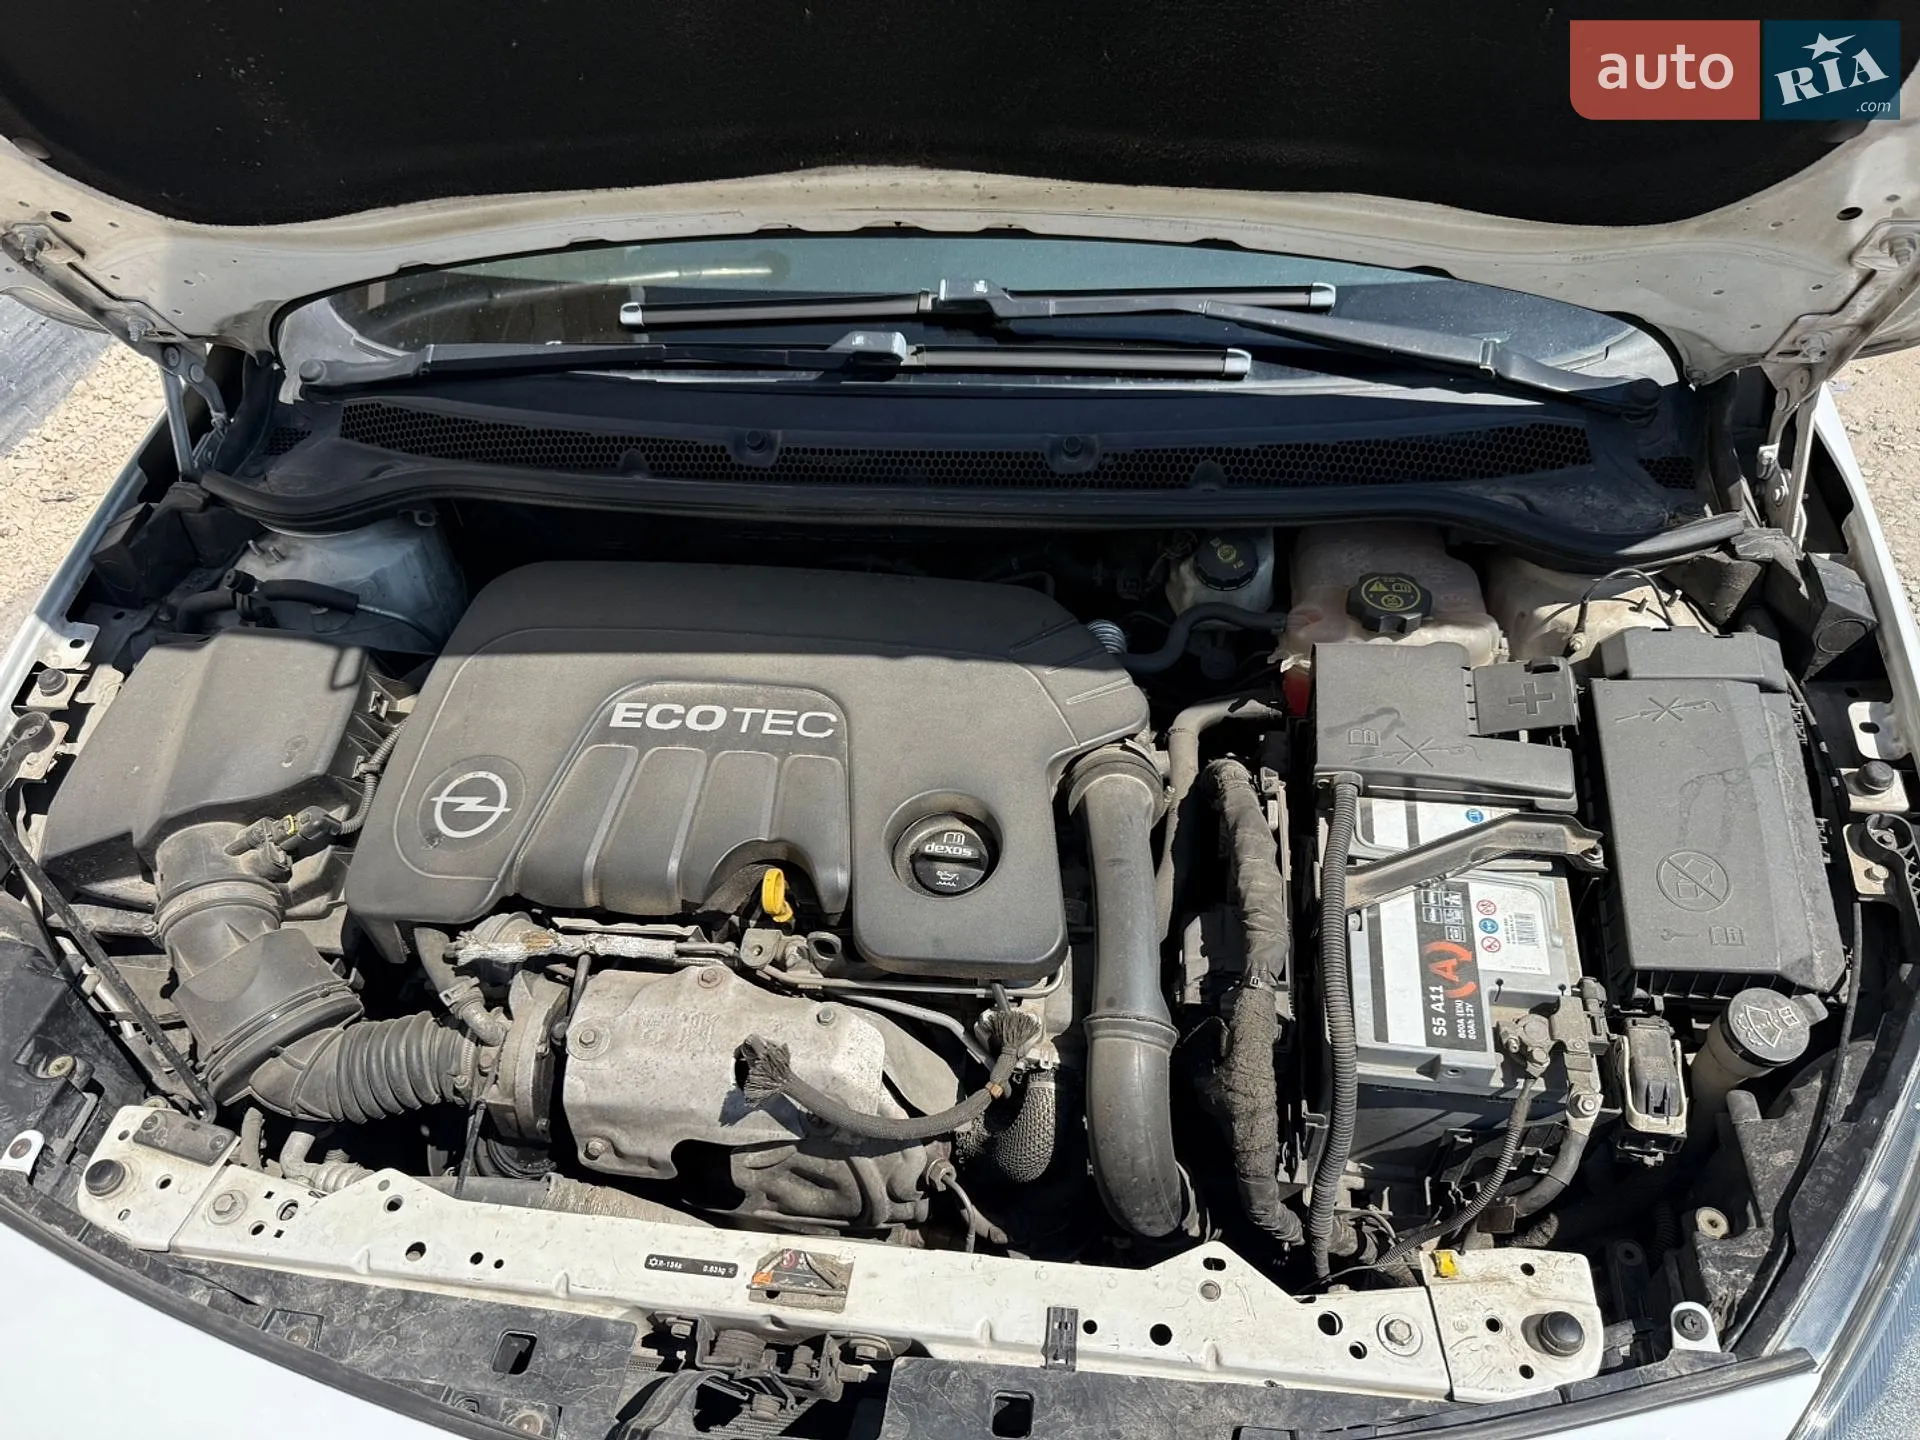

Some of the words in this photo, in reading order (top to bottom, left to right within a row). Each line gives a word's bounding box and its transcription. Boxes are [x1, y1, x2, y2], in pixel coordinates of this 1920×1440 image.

[609, 702, 837, 739] ECOTEC
[924, 842, 973, 857] dexos
[1429, 985, 1446, 1013] A11
[1432, 1017, 1448, 1036] S5
